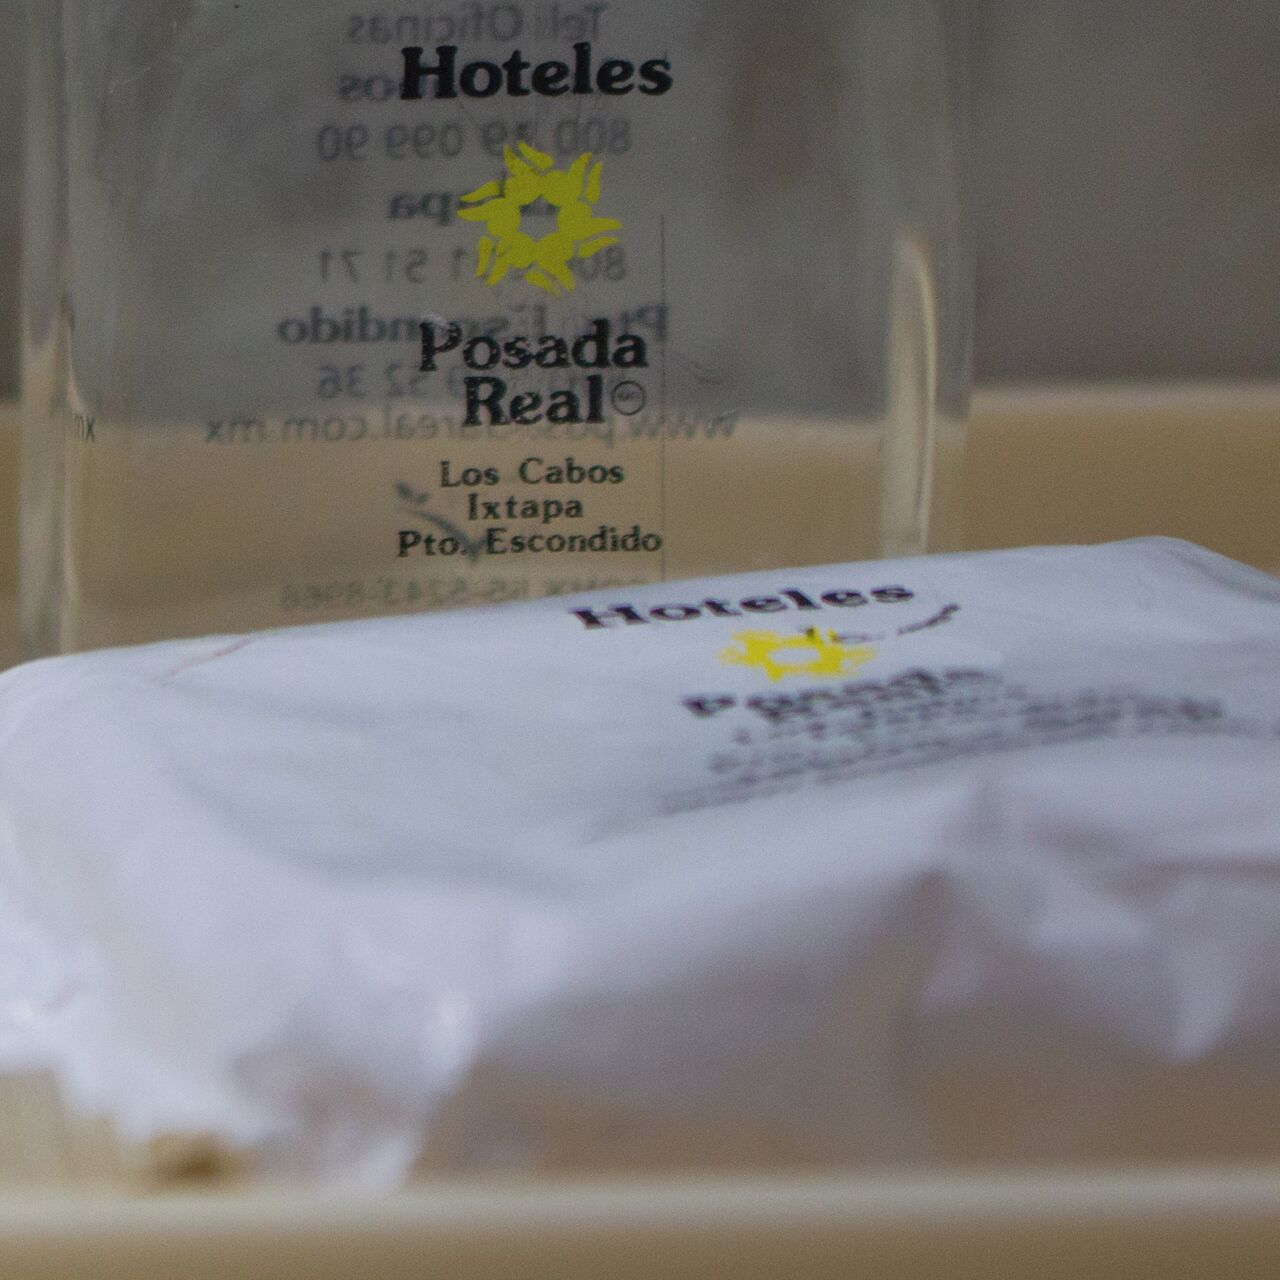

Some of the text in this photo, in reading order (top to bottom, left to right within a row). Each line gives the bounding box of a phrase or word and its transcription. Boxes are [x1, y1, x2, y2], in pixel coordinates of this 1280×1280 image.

[399, 41, 673, 101] Hoteles
[418, 318, 648, 372] Posada
[463, 373, 603, 427] Real
[440, 457, 626, 488] Los Cabos
[468, 492, 584, 524] Ixtapa
[397, 525, 664, 559] Pto. Escondido
[570, 584, 915, 630] Hoteles
